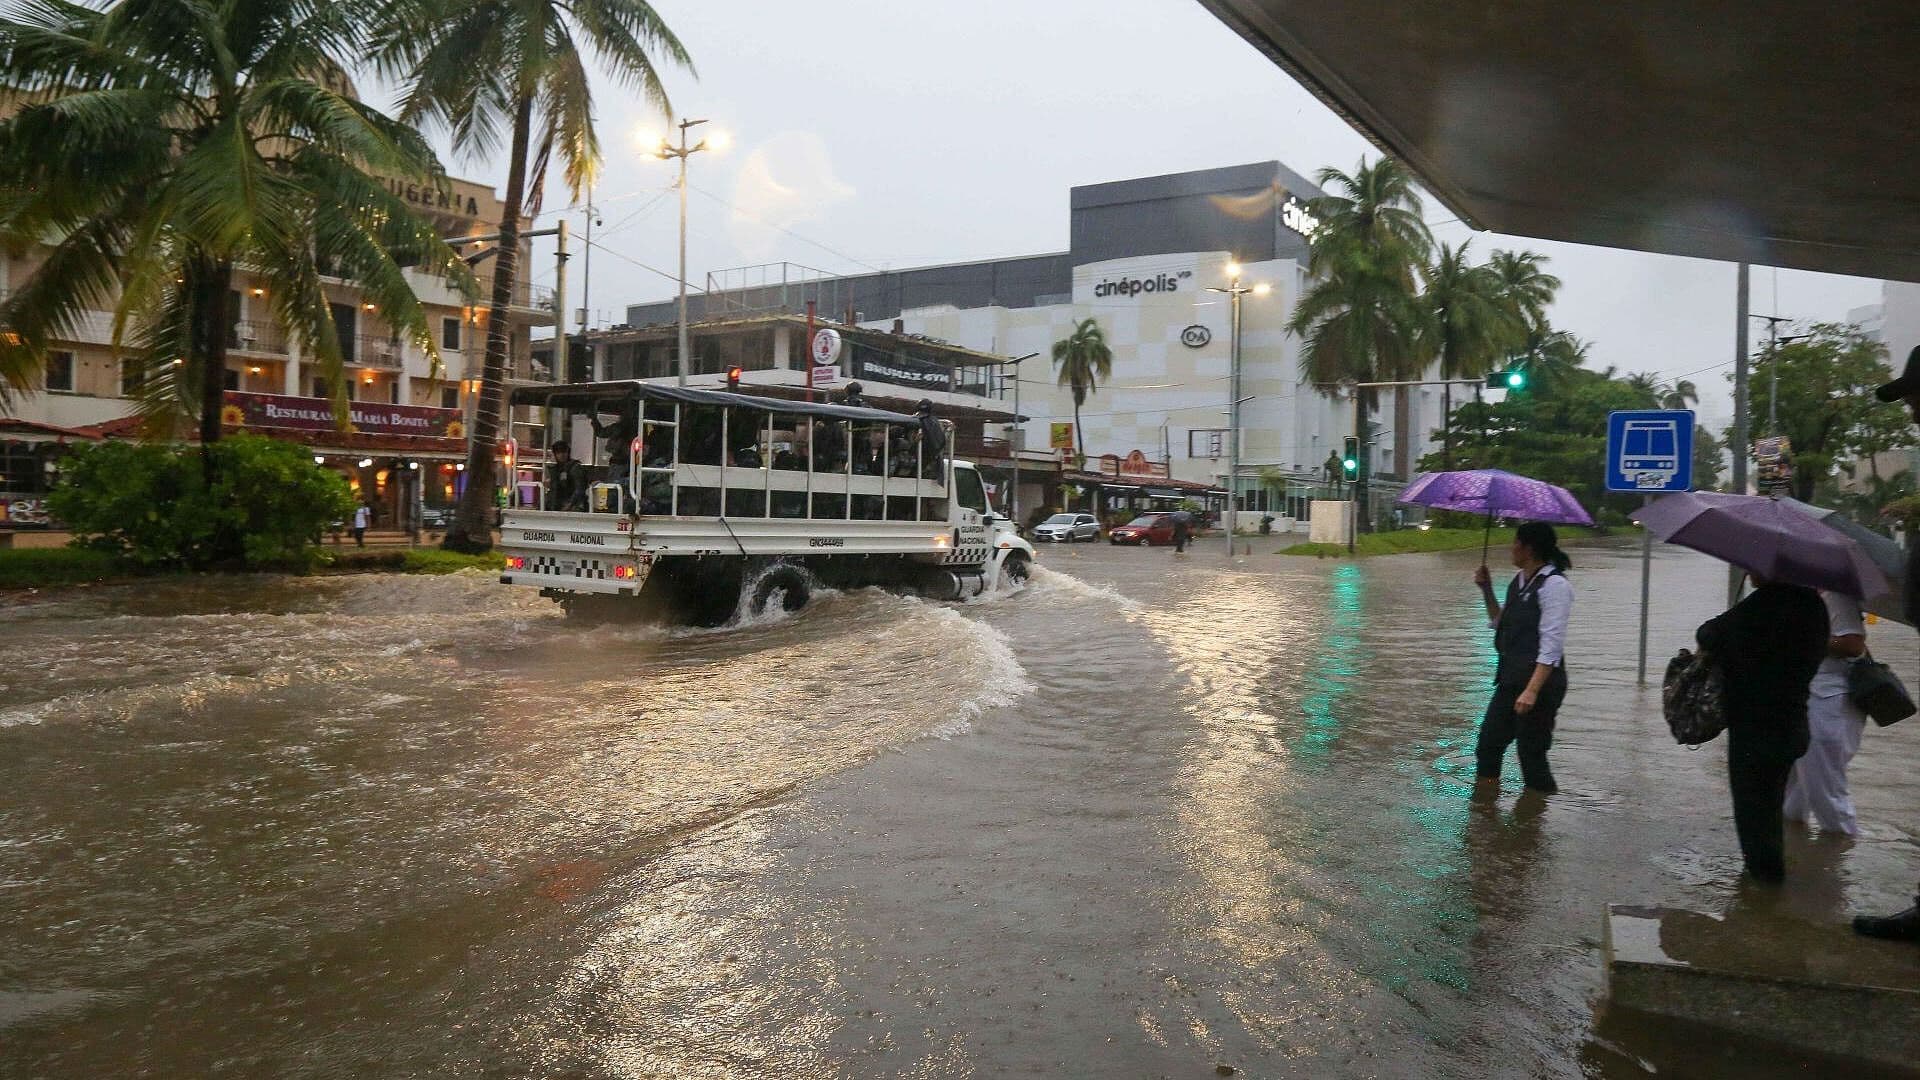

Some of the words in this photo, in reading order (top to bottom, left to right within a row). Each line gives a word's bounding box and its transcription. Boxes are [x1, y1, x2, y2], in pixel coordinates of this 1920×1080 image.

[1095, 273, 1178, 298] cinépolis
[266, 404, 337, 422] RESTAURAN
[391, 413, 429, 428] BONITA
[961, 525, 985, 533] GUARDIA
[523, 531, 556, 542] GUARDIA
[570, 534, 605, 546] NACIONAL
[960, 537, 987, 545] NACIONAL
